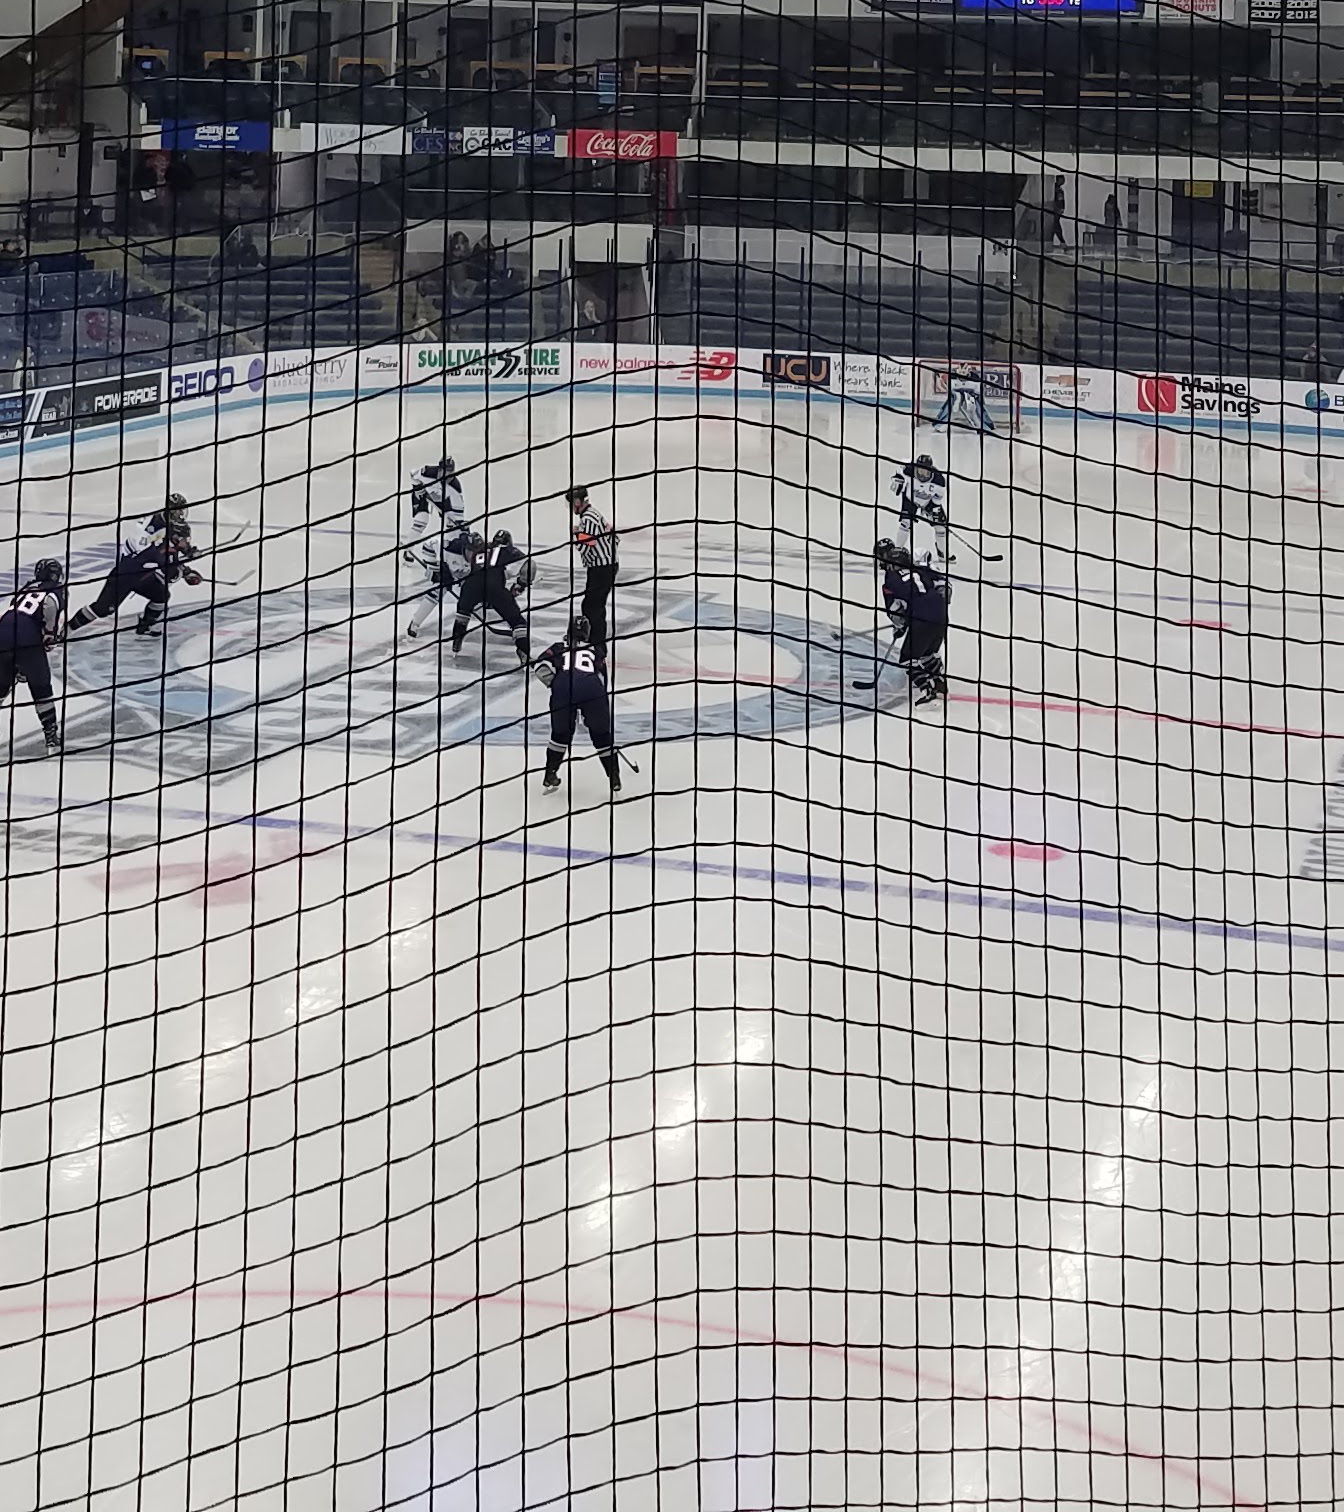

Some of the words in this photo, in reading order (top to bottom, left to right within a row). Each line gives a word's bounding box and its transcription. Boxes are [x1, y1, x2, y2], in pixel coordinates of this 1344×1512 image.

[1286, 10, 1318, 20] 2012
[413, 137, 444, 150] CES
[273, 355, 348, 381] blueberry
[418, 348, 497, 368] SULLIVAN
[523, 348, 560, 367] TIRE
[579, 358, 610, 369] new
[613, 357, 677, 370] balance
[464, 368, 493, 376] AUTO
[517, 367, 560, 377] SERVICE
[765, 356, 828, 383] UCU
[170, 365, 235, 402] GEICO
[273, 376, 336, 388] BROADCATING
[1181, 375, 1247, 396] Maine
[95, 385, 158, 413] POWERADE
[1043, 389, 1091, 398] CHEVRLET
[1180, 393, 1262, 418] Savings
[561, 648, 597, 674] 16
